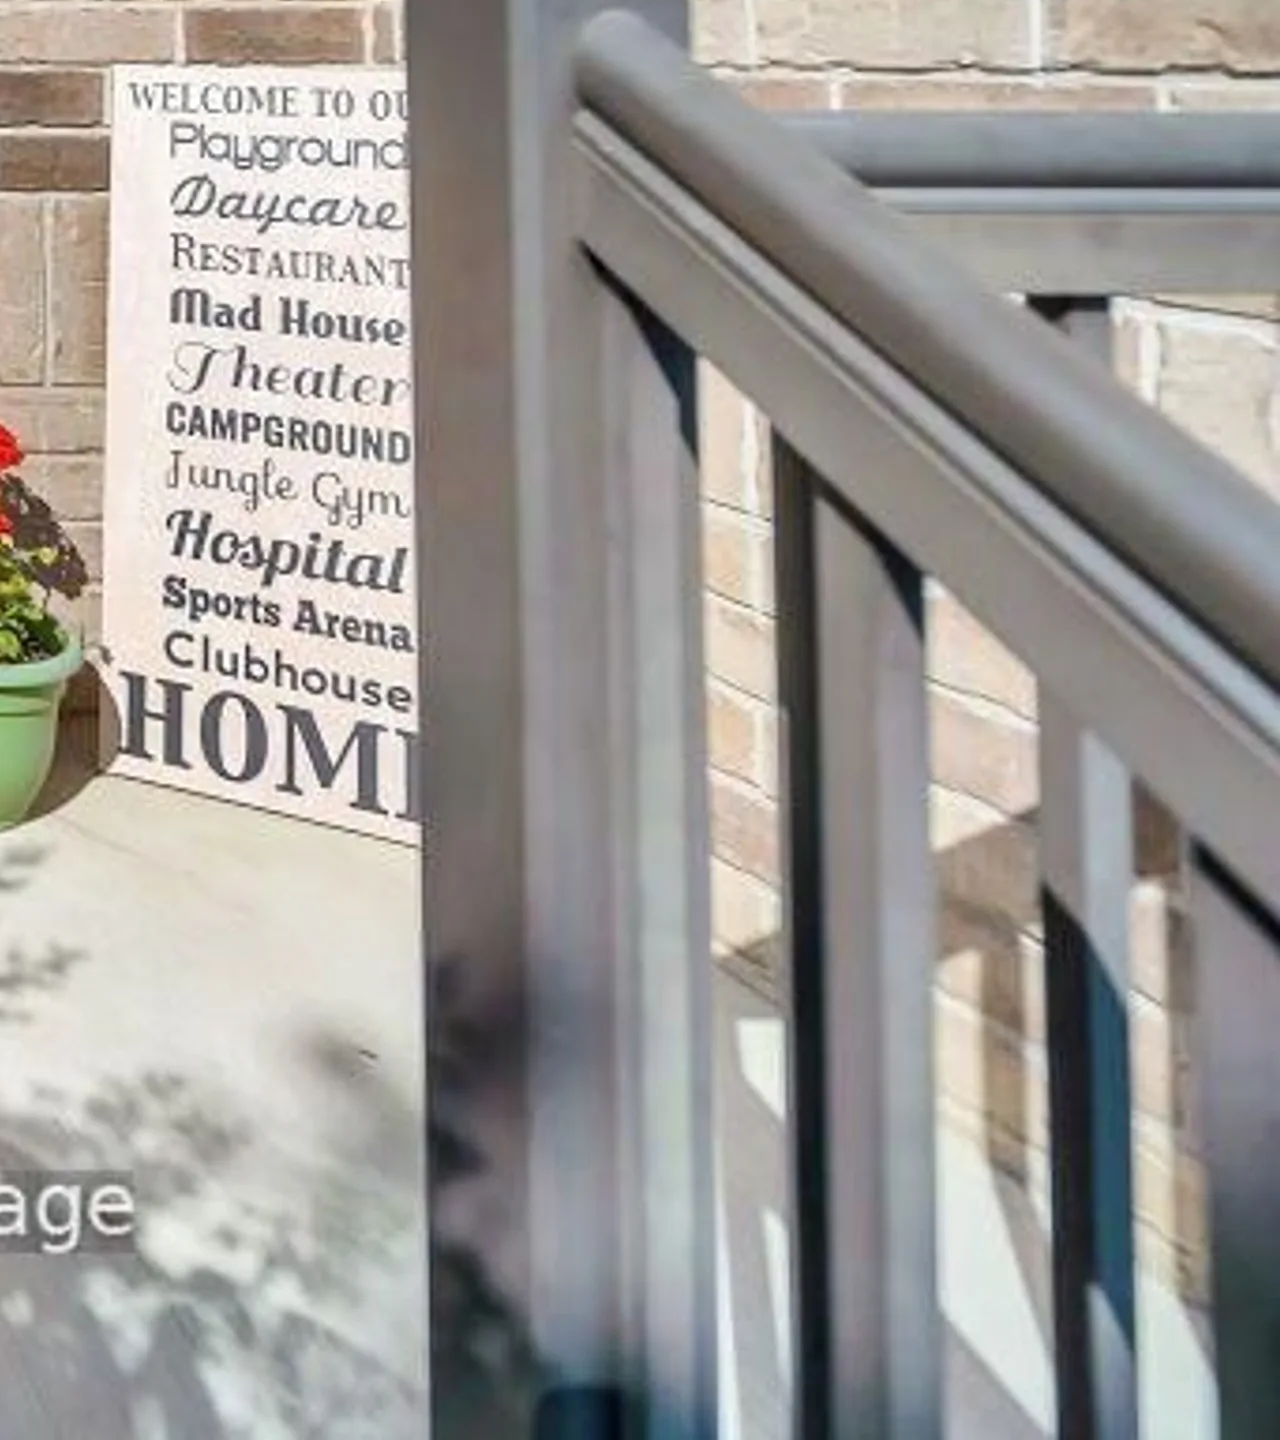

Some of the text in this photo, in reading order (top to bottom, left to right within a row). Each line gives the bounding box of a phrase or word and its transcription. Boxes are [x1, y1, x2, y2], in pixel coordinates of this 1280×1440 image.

[128, 82, 408, 121] WELCOME TO OU
[169, 122, 410, 171] Playground
[170, 174, 407, 234] Daycare
[170, 232, 410, 290] RESTAURANT
[169, 288, 407, 346] Mad House
[166, 341, 412, 406] Theater
[166, 402, 411, 463] CAMPGROUND
[166, 449, 412, 529] Jungle Gym
[166, 509, 409, 594] Hospital
[162, 575, 414, 654] Sports Arena
[164, 631, 413, 714] Clubhouse
